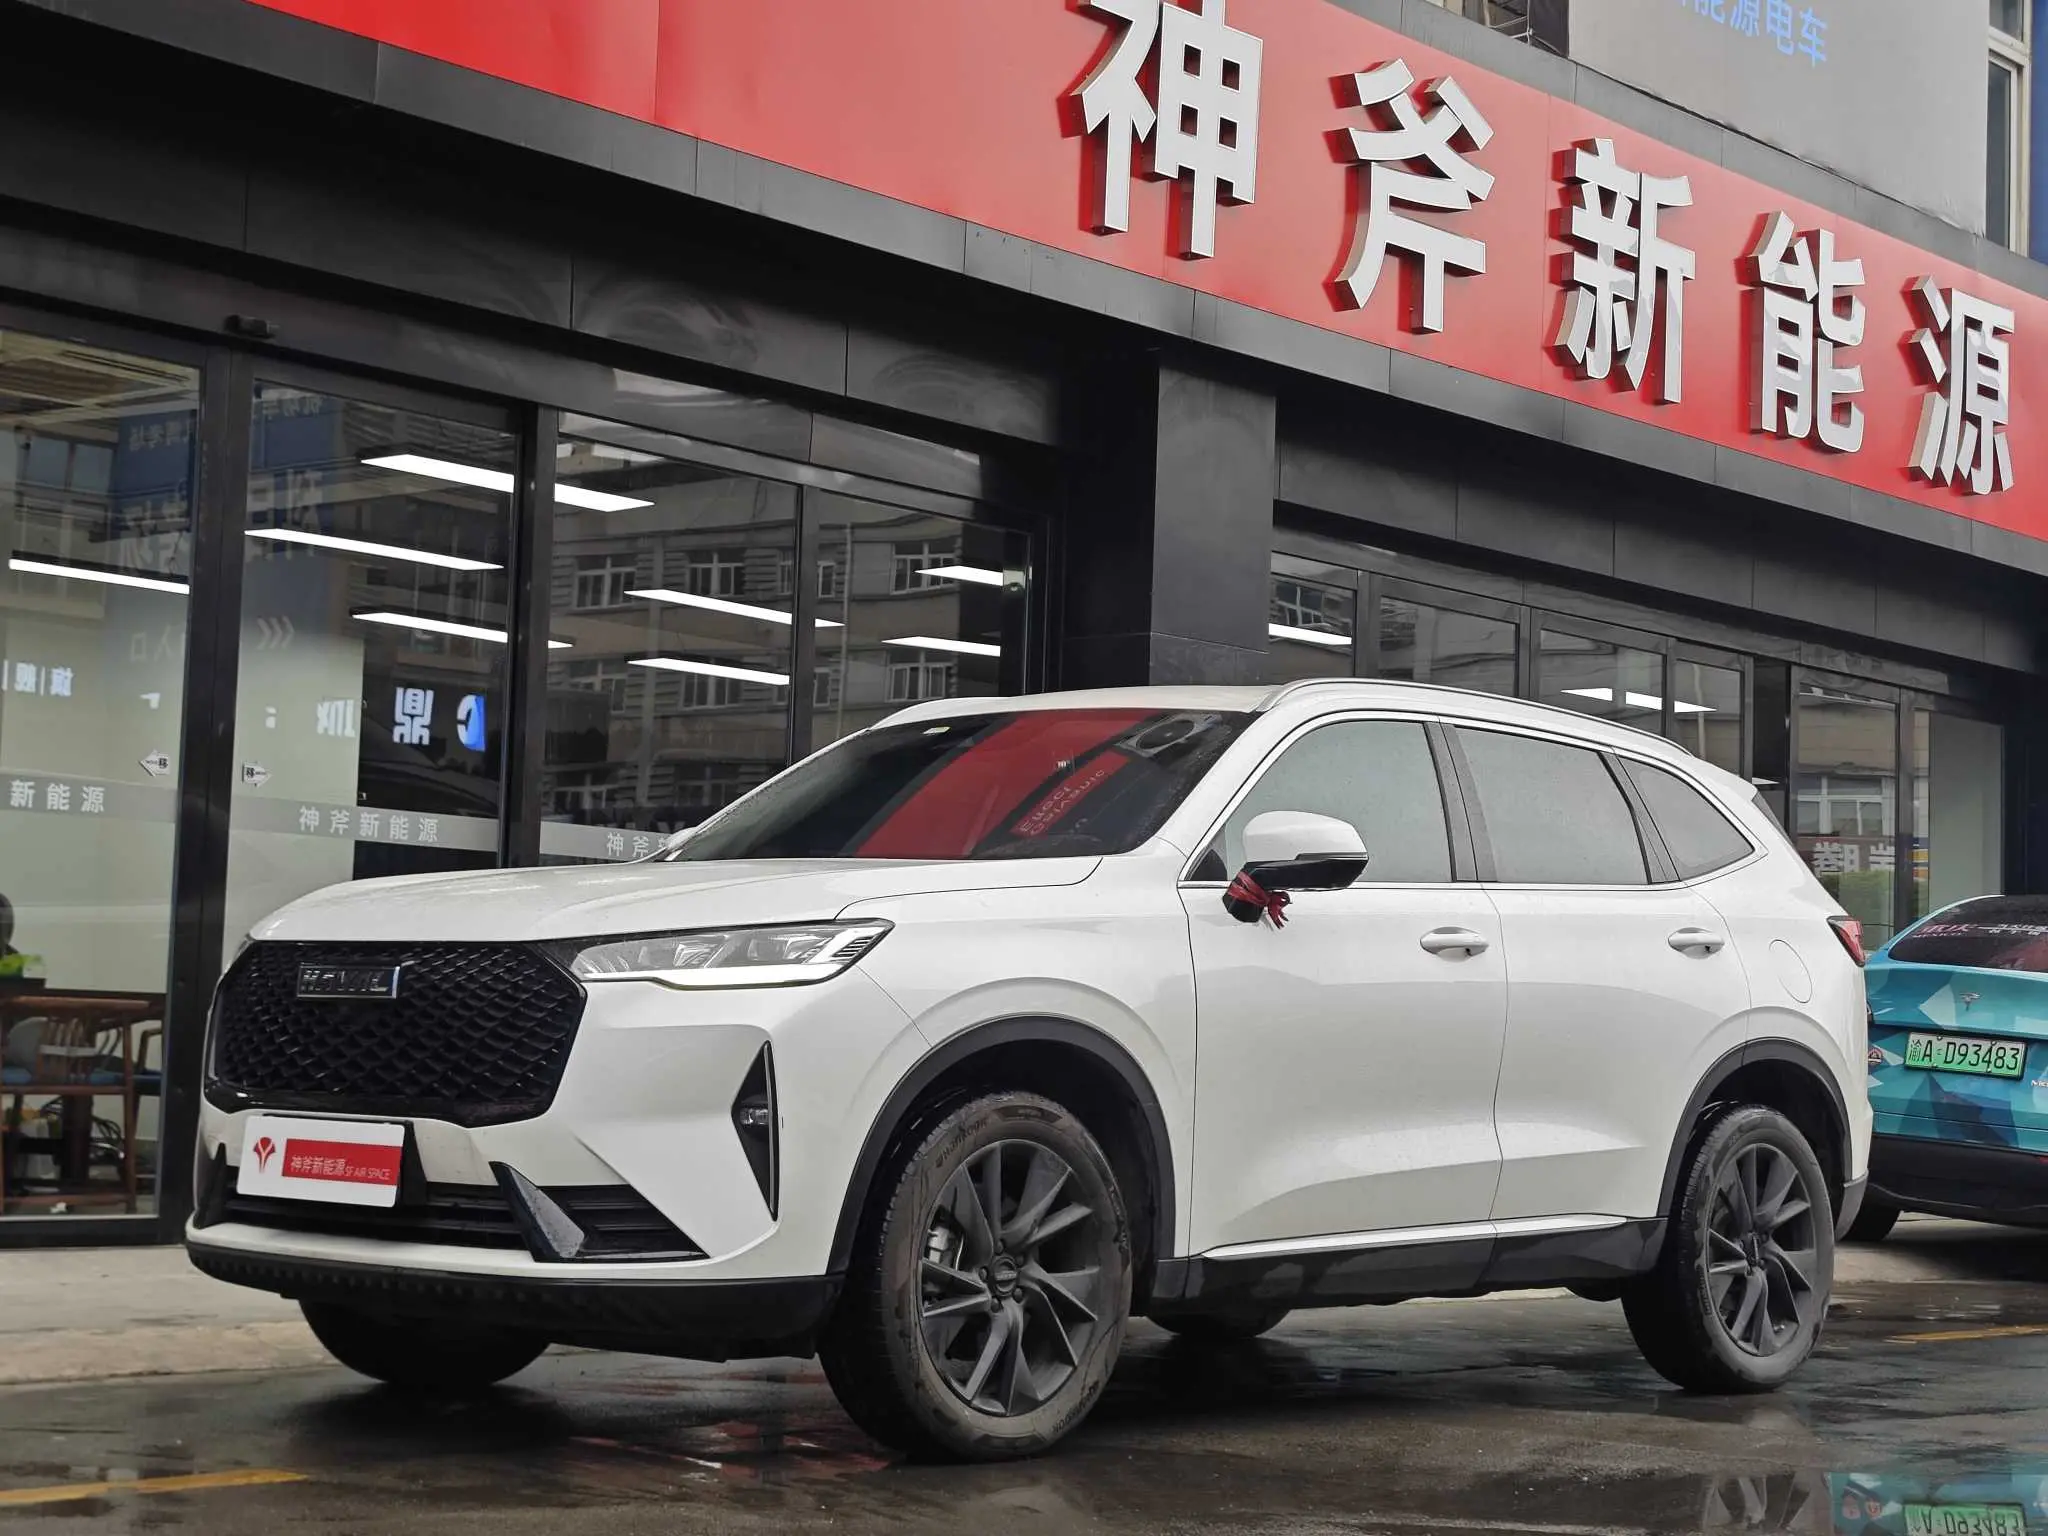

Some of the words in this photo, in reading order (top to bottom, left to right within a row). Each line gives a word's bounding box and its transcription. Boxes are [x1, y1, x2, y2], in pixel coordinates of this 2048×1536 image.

[1071, 0, 2016, 495] 神斧新能源
[10, 779, 105, 814] 新能源
[299, 805, 438, 843] 神斧新能源
[290, 1155, 346, 1177] 神斧新能源
[367, 1167, 392, 1181] SPACE
